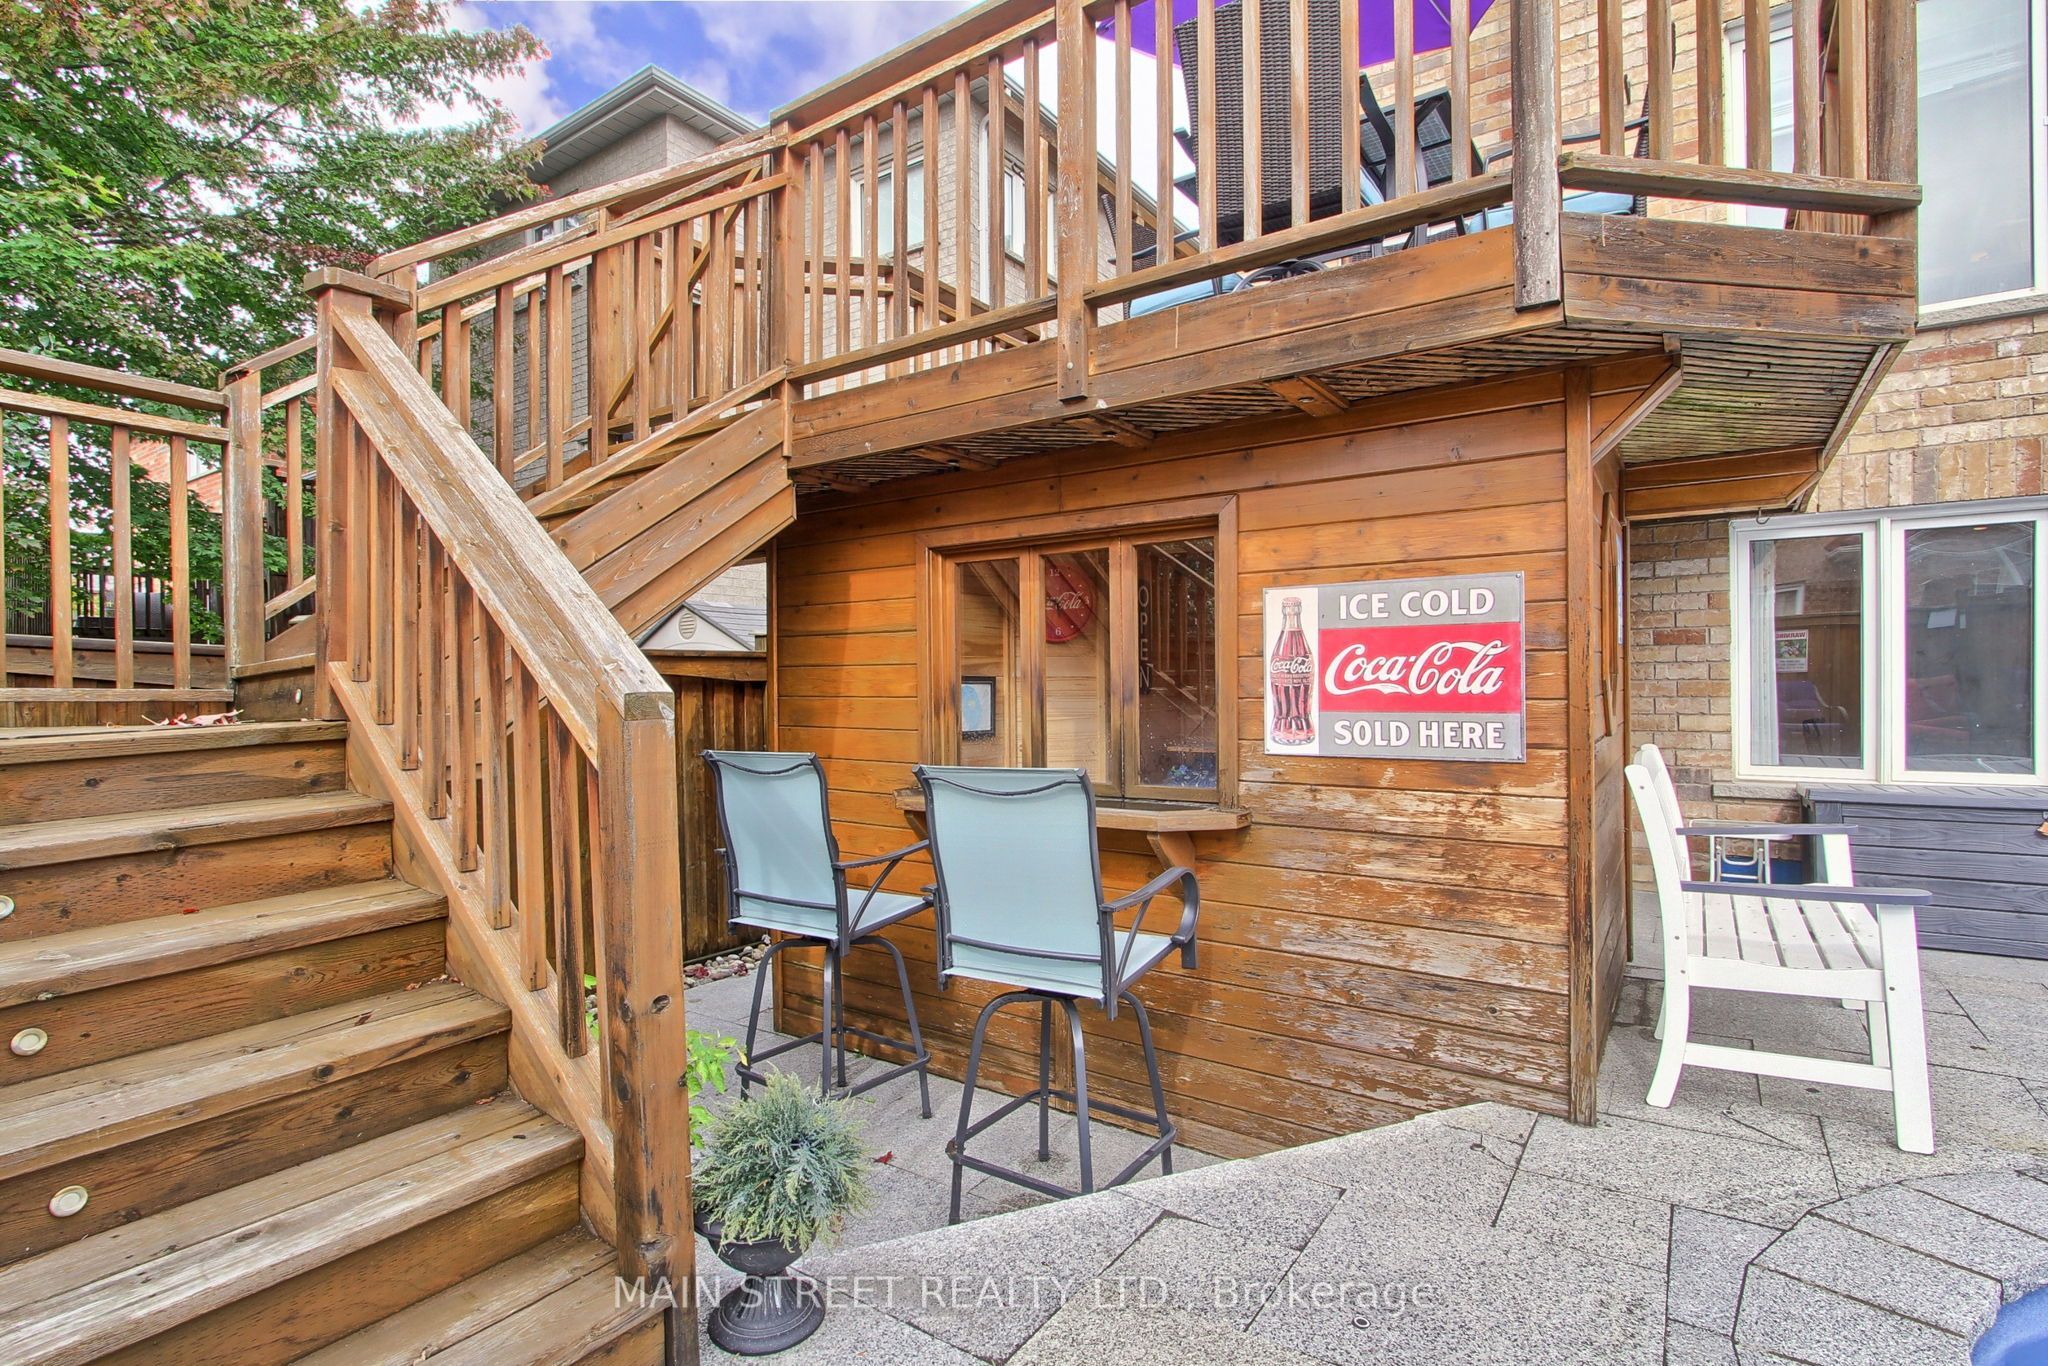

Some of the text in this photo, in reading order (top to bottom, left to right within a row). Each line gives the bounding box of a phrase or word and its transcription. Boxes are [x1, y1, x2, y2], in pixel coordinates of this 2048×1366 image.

[1339, 588, 1495, 620] ICE COLD
[1139, 585, 1150, 688] OPEN
[1324, 640, 1511, 696] Coca-Cola
[1333, 719, 1505, 750] SOLD HERE
